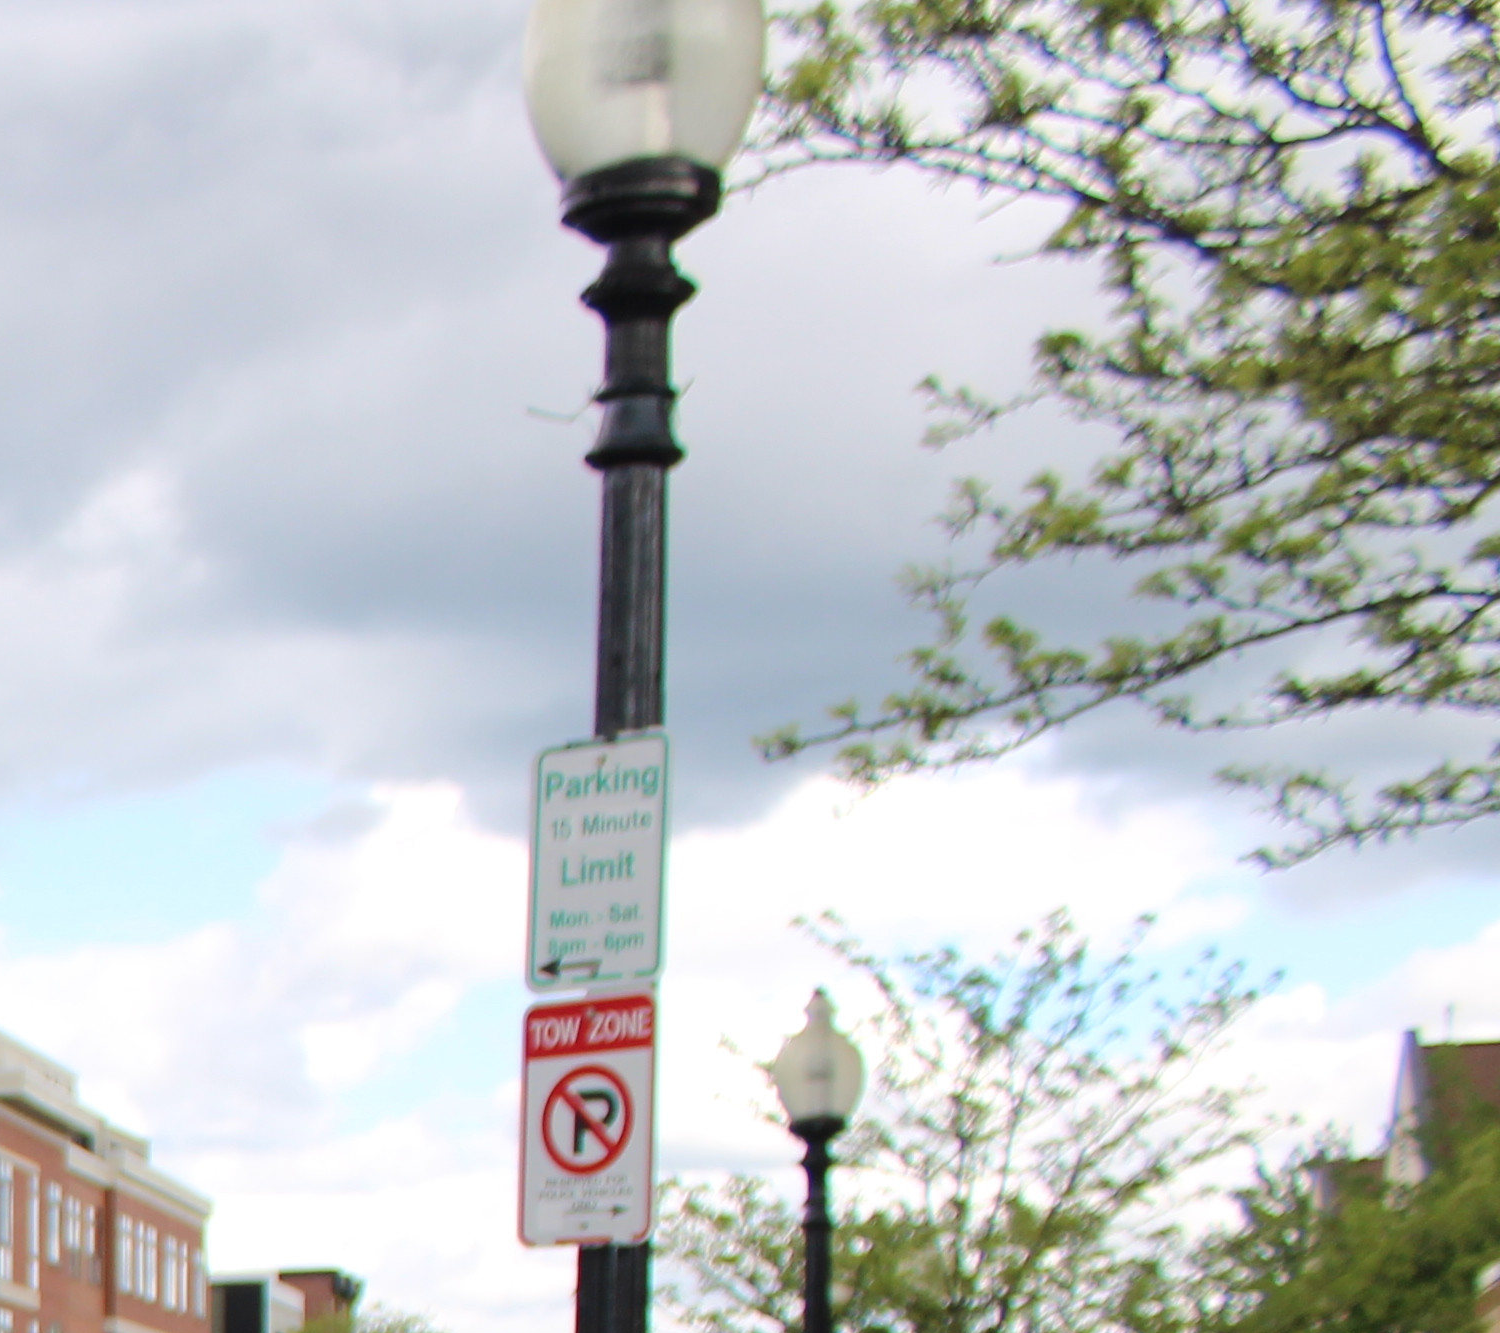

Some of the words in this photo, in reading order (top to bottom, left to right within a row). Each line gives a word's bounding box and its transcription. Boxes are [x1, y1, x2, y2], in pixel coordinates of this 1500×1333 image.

[546, 764, 659, 799] Parking
[552, 818, 572, 839] 15
[583, 810, 652, 837] Minute
[562, 852, 634, 886] Limit
[604, 928, 644, 954] 6pm
[531, 1017, 581, 1049] TOW
[589, 1006, 652, 1044] ZONE
